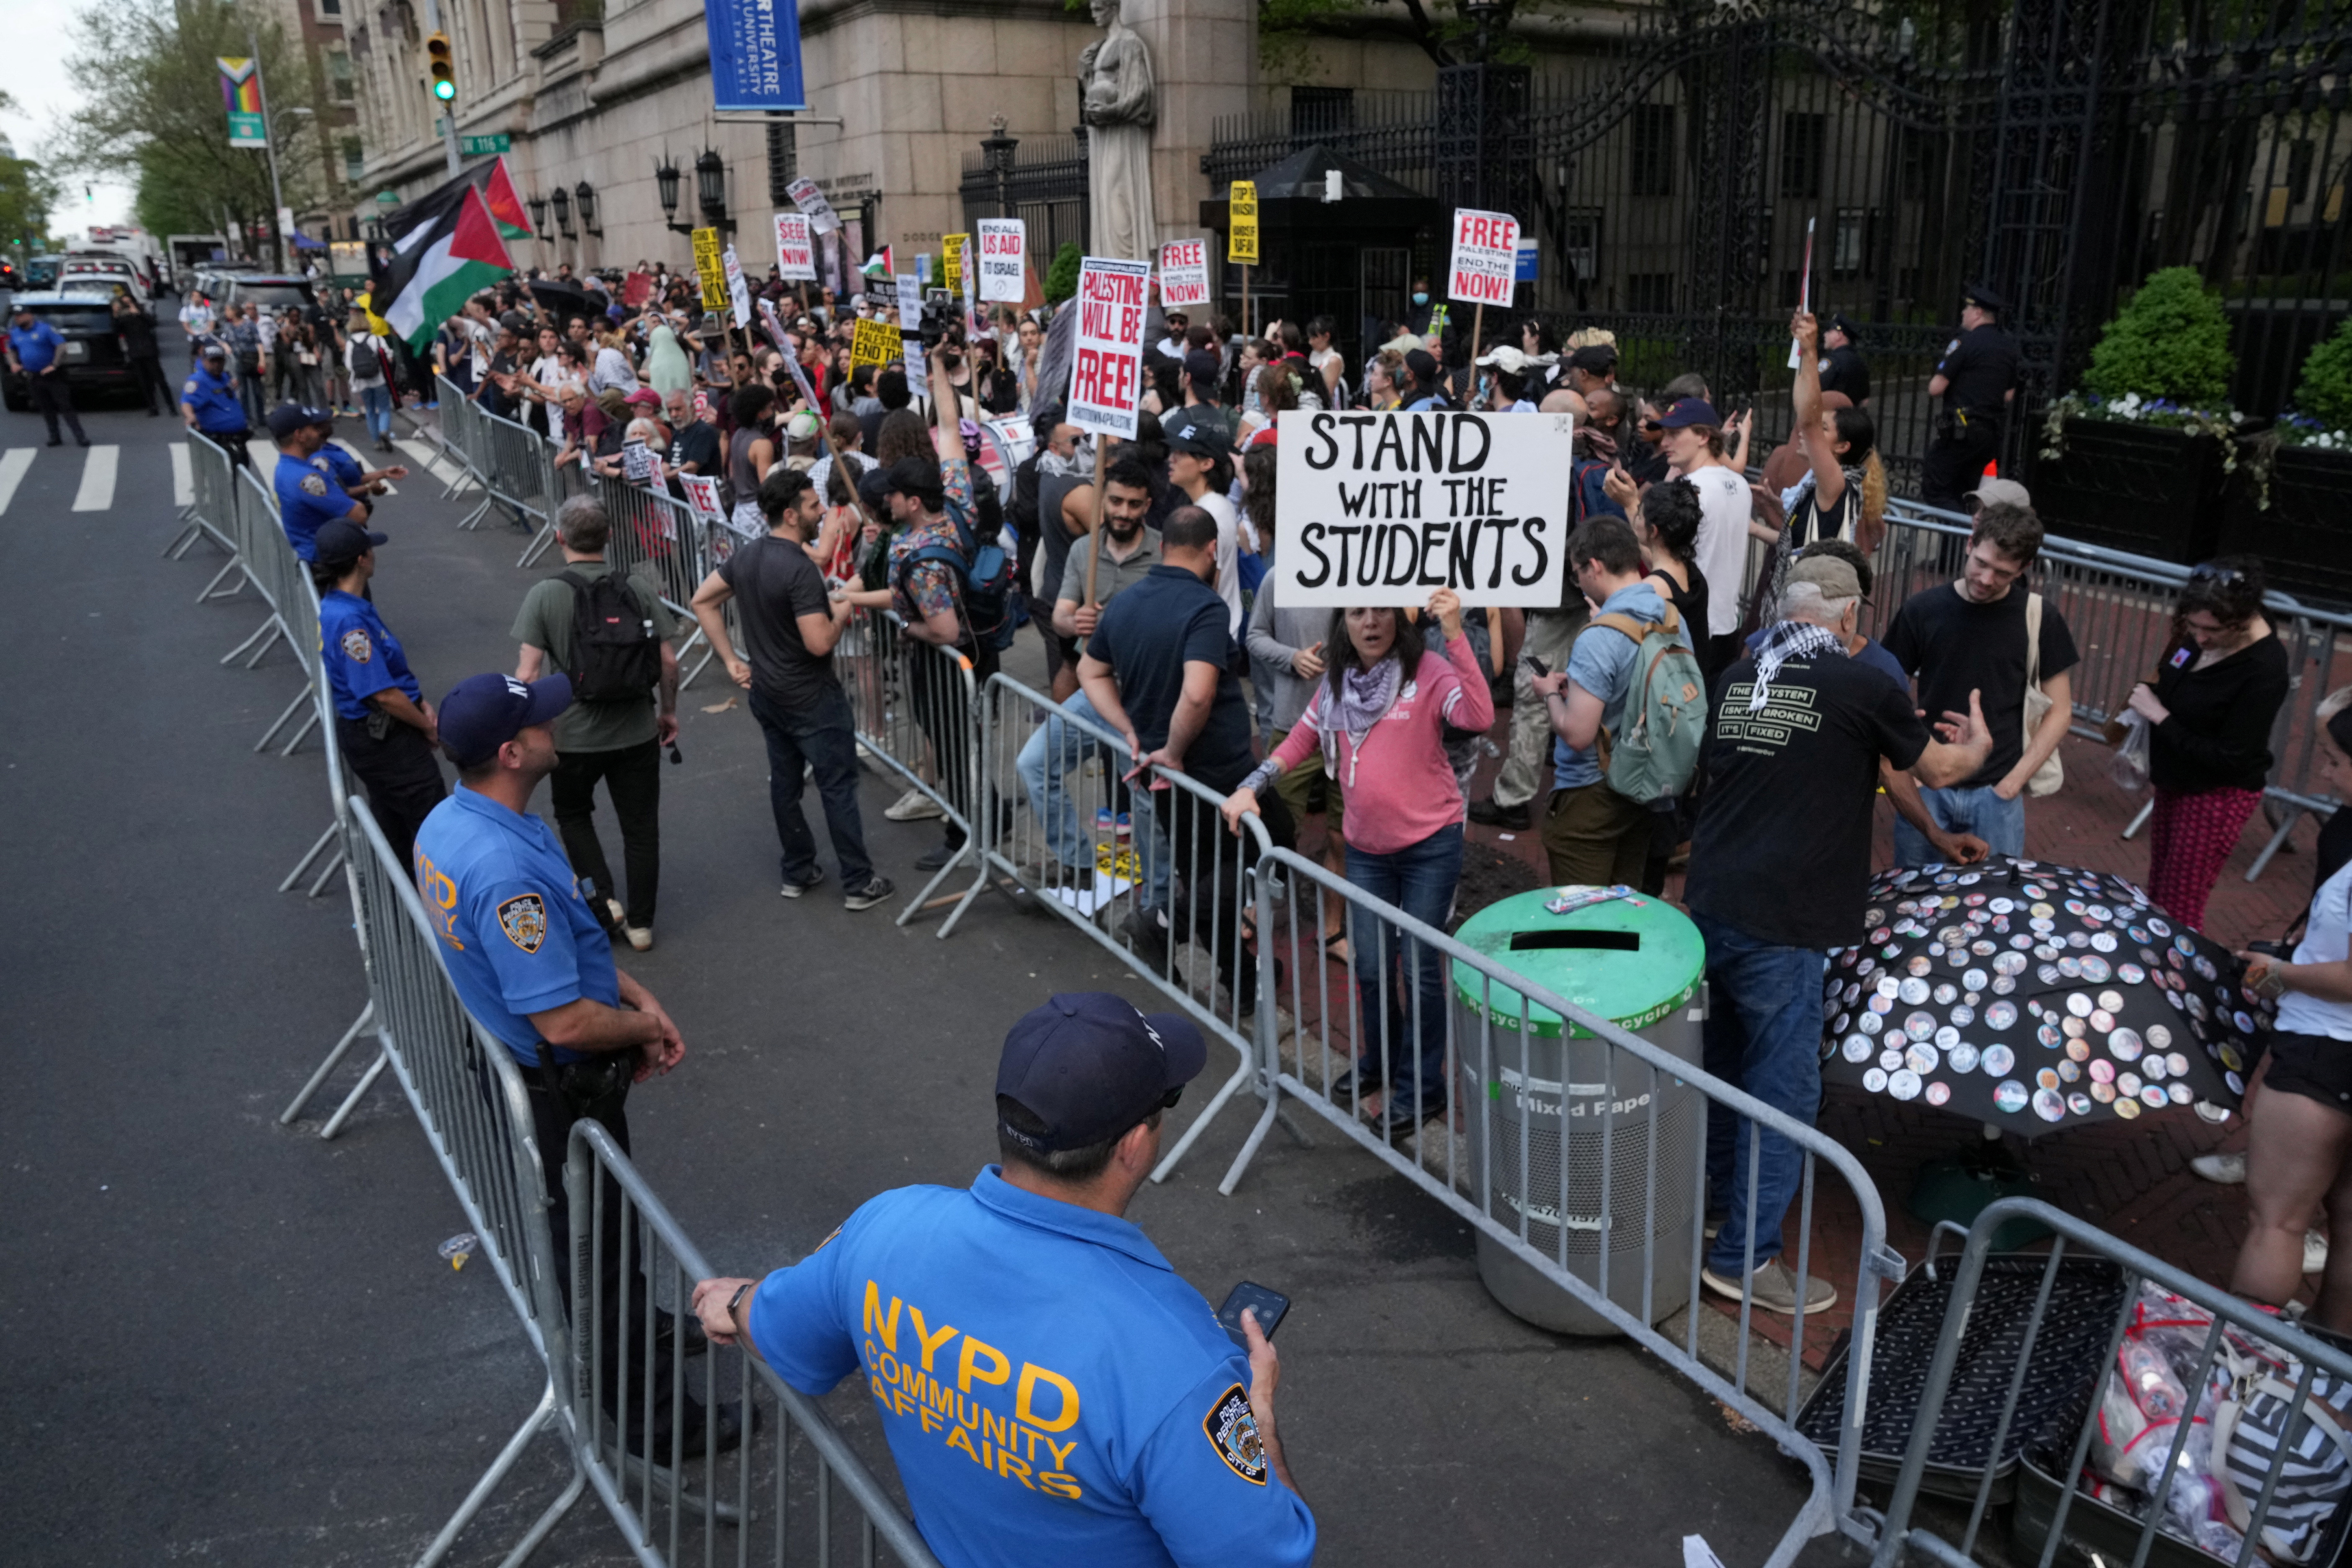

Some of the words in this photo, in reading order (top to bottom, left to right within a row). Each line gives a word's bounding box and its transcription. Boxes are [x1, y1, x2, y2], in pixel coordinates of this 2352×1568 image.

[478, 137, 496, 152] 116
[1001, 225, 1020, 234] ALL
[1460, 216, 1515, 250] FREE
[983, 235, 996, 254] US
[999, 235, 1020, 255] AID
[1163, 243, 1202, 267] FREE
[1459, 245, 1512, 259] PALESTINE
[1457, 257, 1483, 267] END
[1488, 260, 1510, 271] THE
[1083, 271, 1144, 306] PALESTINE
[1166, 284, 1205, 302] NOW!
[1455, 271, 1509, 301] NOW!
[1082, 301, 1114, 340] WILL
[1120, 306, 1141, 345] BE
[856, 342, 880, 359] END
[857, 331, 903, 349] PALESTIN
[1073, 348, 1136, 411] FREE!
[1305, 413, 1491, 473] STAND
[1339, 478, 1422, 518] WITH
[1442, 477, 1507, 516] THE
[1296, 517, 1548, 590] STUDENTS
[1731, 686, 1751, 696] THE
[1767, 688, 1808, 701] YSTEM
[1725, 706, 1750, 715] ISN'T
[1762, 707, 1814, 725] BROKEN
[1721, 725, 1739, 733] IT'S
[1750, 726, 1784, 739] FIXED
[863, 1279, 1080, 1433] NYPD
[865, 1339, 1078, 1471] COMMUNITY
[1219, 1395, 1241, 1422] POLICE
[872, 1375, 1082, 1499] AFFAIRS
[1227, 1452, 1245, 1471] CITY
[1246, 1467, 1256, 1476] OF
